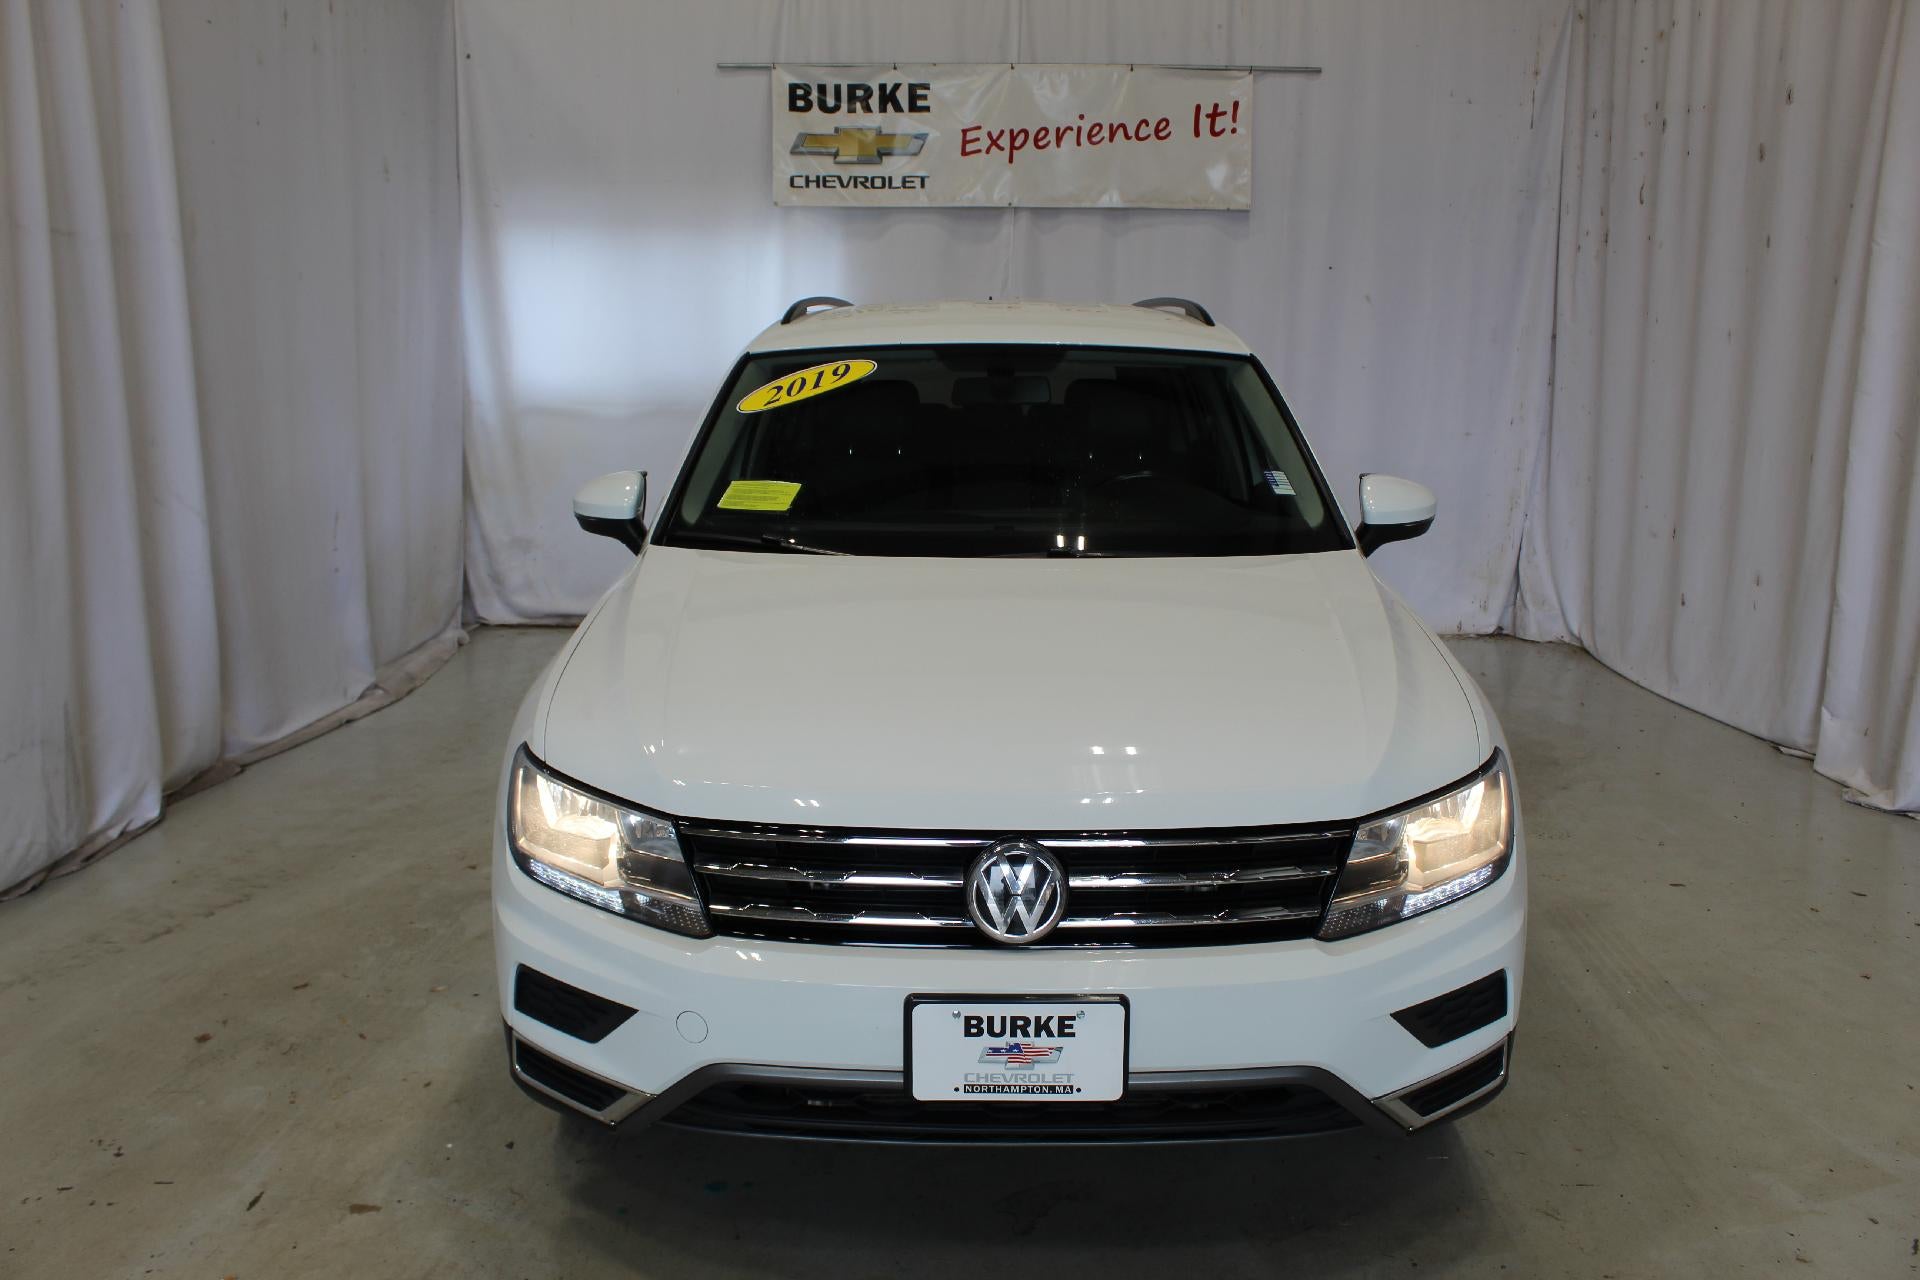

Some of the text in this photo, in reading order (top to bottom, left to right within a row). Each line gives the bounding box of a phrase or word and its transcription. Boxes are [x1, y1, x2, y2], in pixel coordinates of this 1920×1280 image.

[788, 82, 931, 114] BURKE
[960, 100, 1240, 164] Experience It!
[789, 174, 930, 190] CHEVROLET
[763, 363, 851, 407] 2019
[964, 1015, 1076, 1038] BURKE
[964, 1073, 1075, 1084] CHEVROLET
[1055, 1085, 1072, 1094] MA
